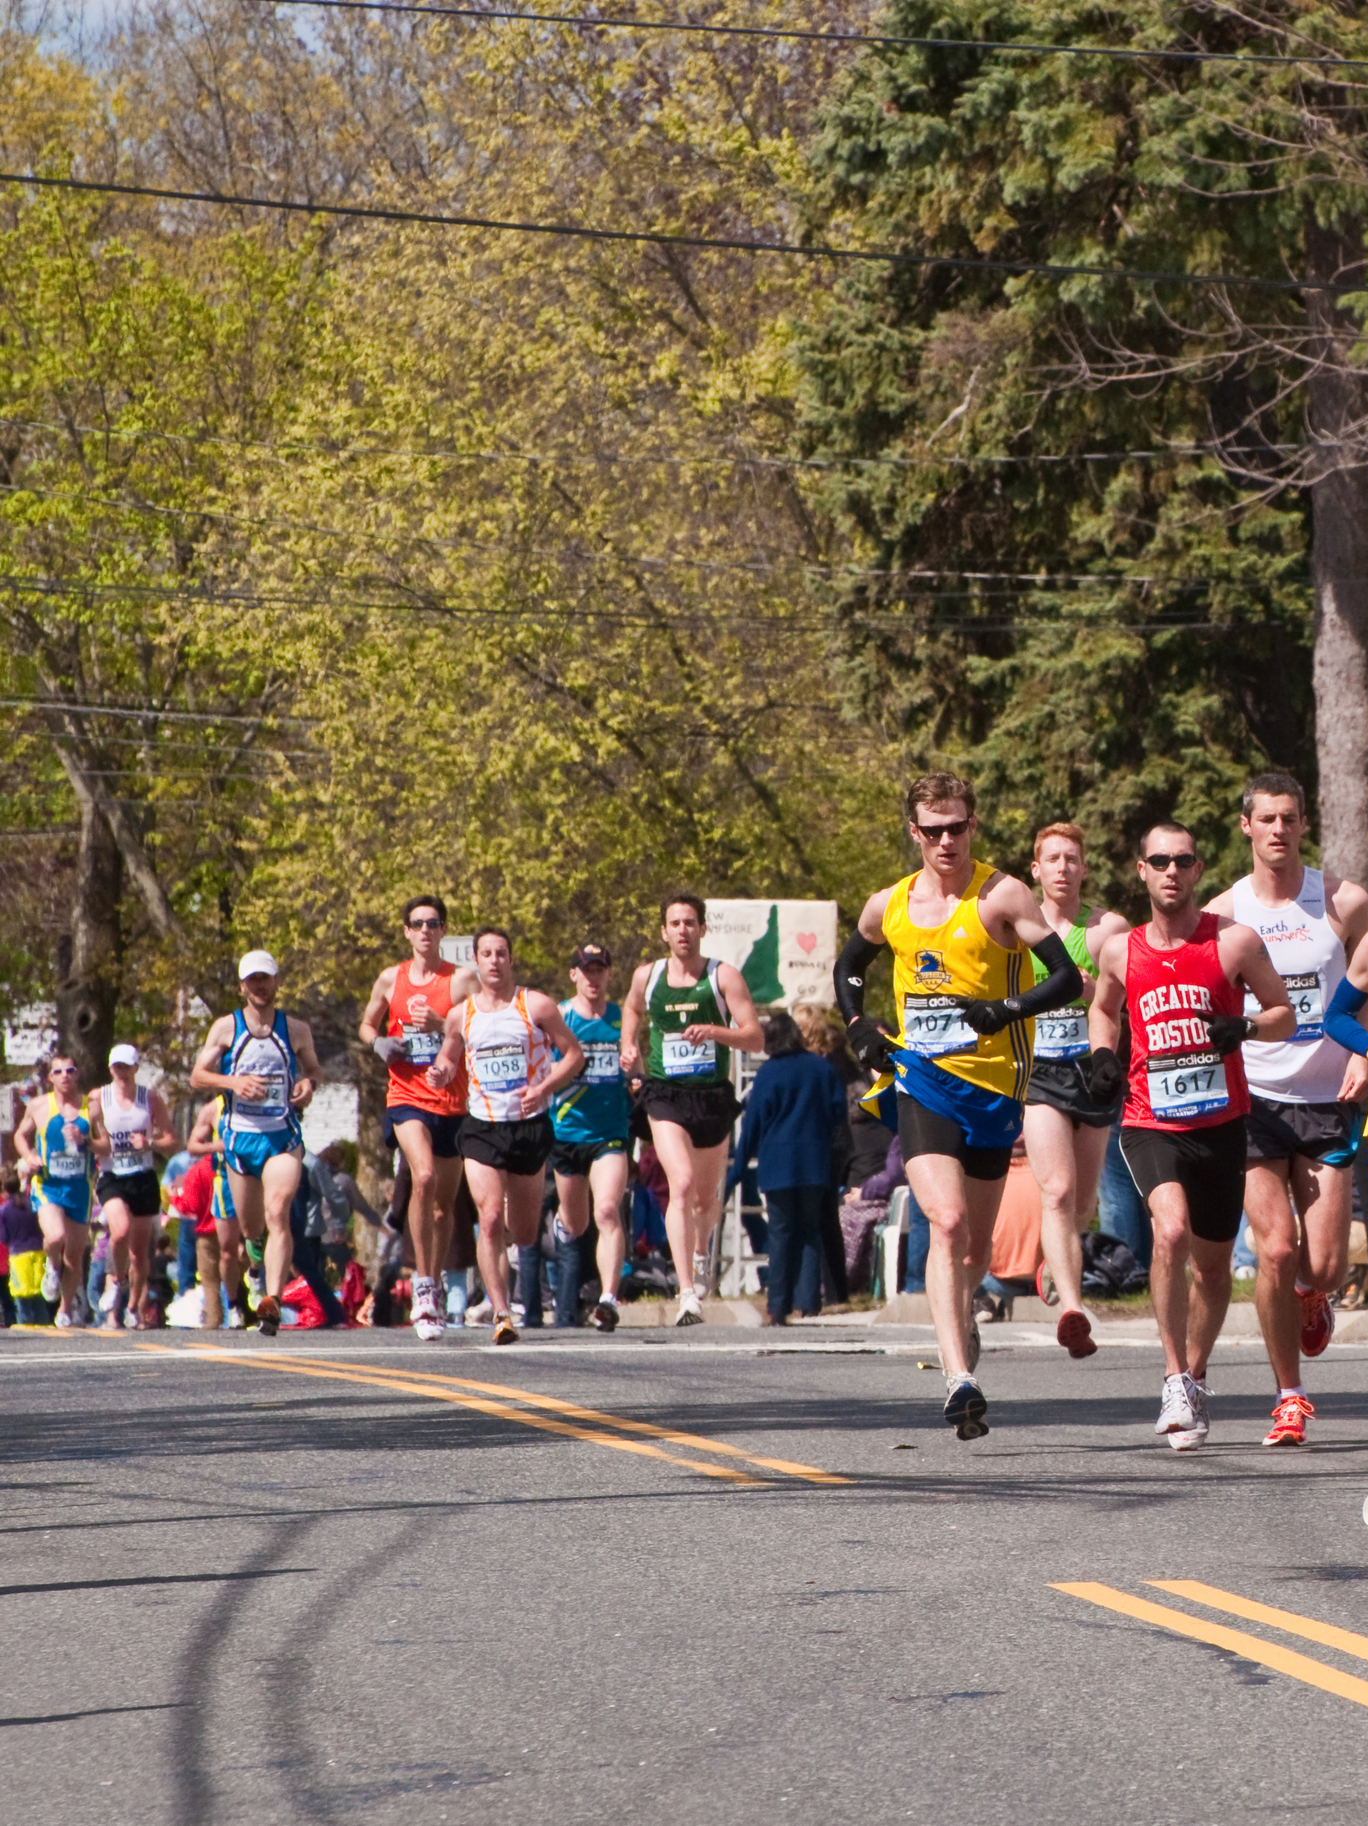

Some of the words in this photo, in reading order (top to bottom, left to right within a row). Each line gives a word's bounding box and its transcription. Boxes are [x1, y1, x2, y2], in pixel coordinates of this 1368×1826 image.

[706, 912, 724, 921] EW
[706, 924, 752, 934] AMPSHIRE
[1260, 920, 1288, 935] Earth
[1283, 975, 1316, 988] didas
[797, 985, 817, 995] GO
[1139, 984, 1213, 1021] GREATER
[1049, 1007, 1085, 1019] adidas
[914, 1013, 965, 1032] 1071
[1038, 1022, 1079, 1038] 1233
[494, 1044, 522, 1056] adidas
[1177, 1051, 1220, 1066] adidas
[483, 1058, 520, 1075] 1058
[1160, 1070, 1215, 1095] 1617
